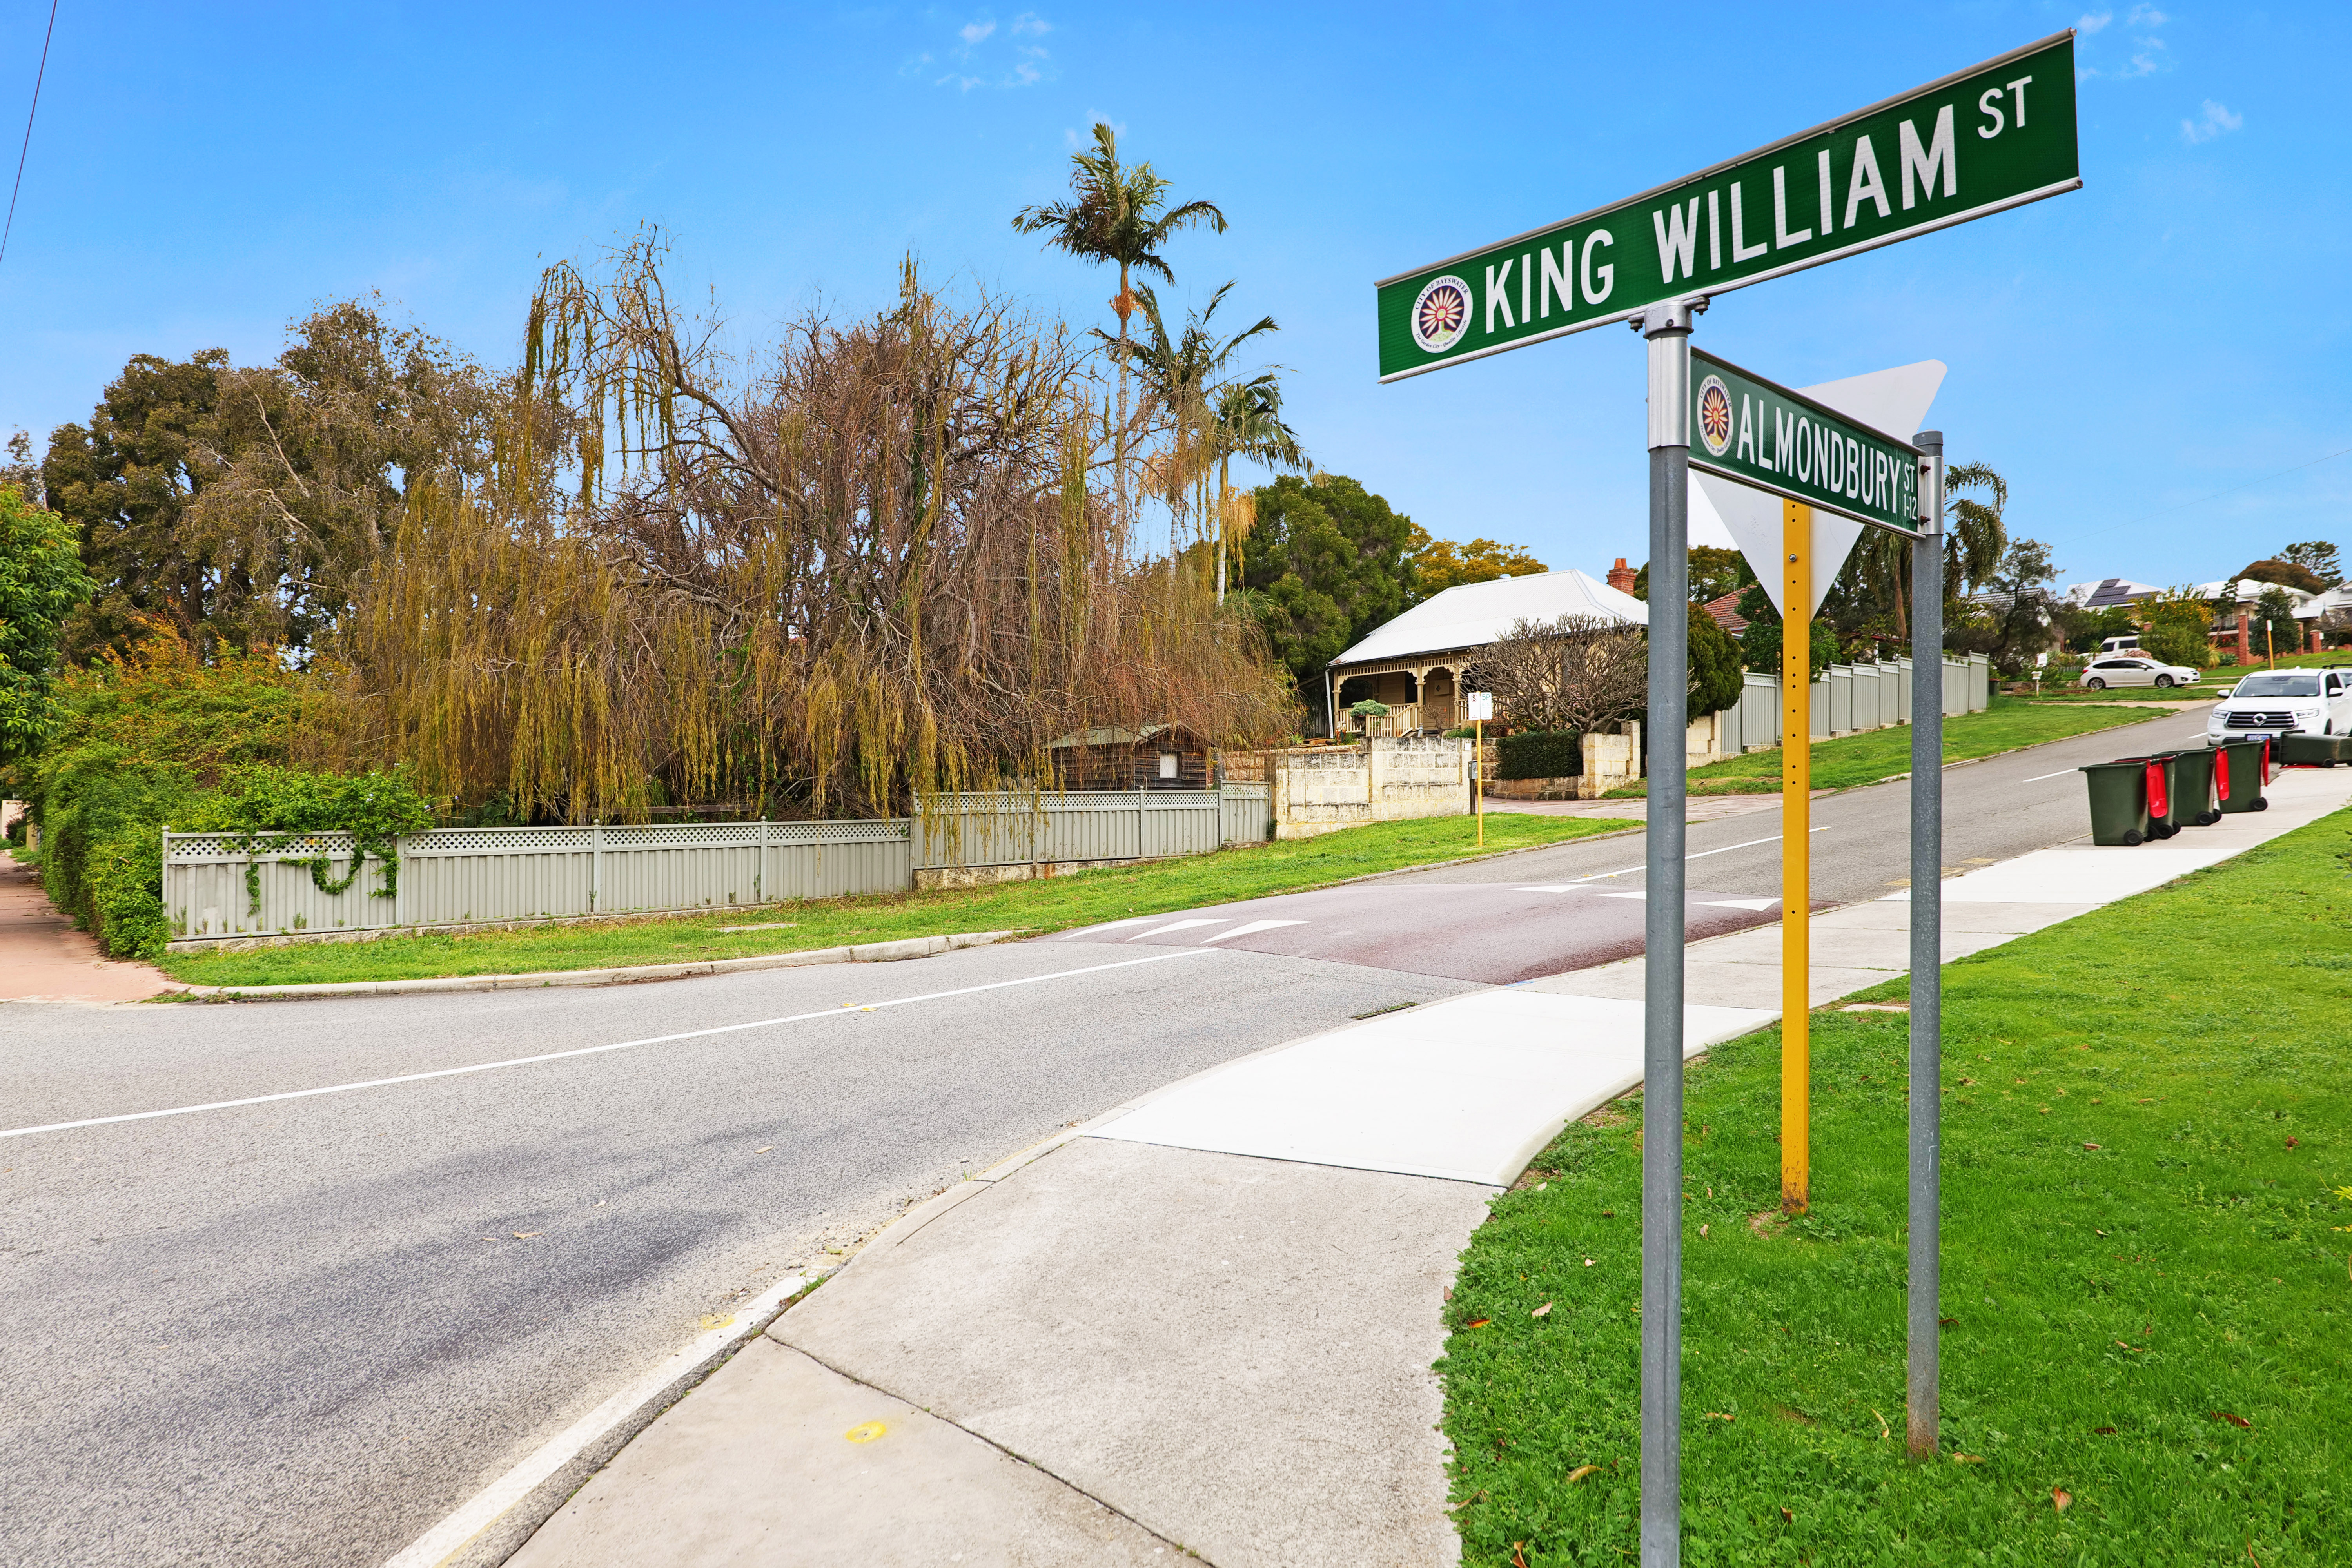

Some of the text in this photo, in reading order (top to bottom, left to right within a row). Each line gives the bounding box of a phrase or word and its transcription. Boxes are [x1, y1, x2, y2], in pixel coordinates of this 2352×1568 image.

[1486, 76, 2032, 334] KING WILLIAM ST
[1415, 278, 1468, 309] CITY OF BAYSWATER
[1421, 339, 1432, 348] Garden
[1443, 337, 1456, 347] Quality
[1456, 319, 1467, 337] Lifestyle
[1737, 393, 1915, 514] ALMONDBURY ST
[1904, 494, 1917, 520] 1-12
